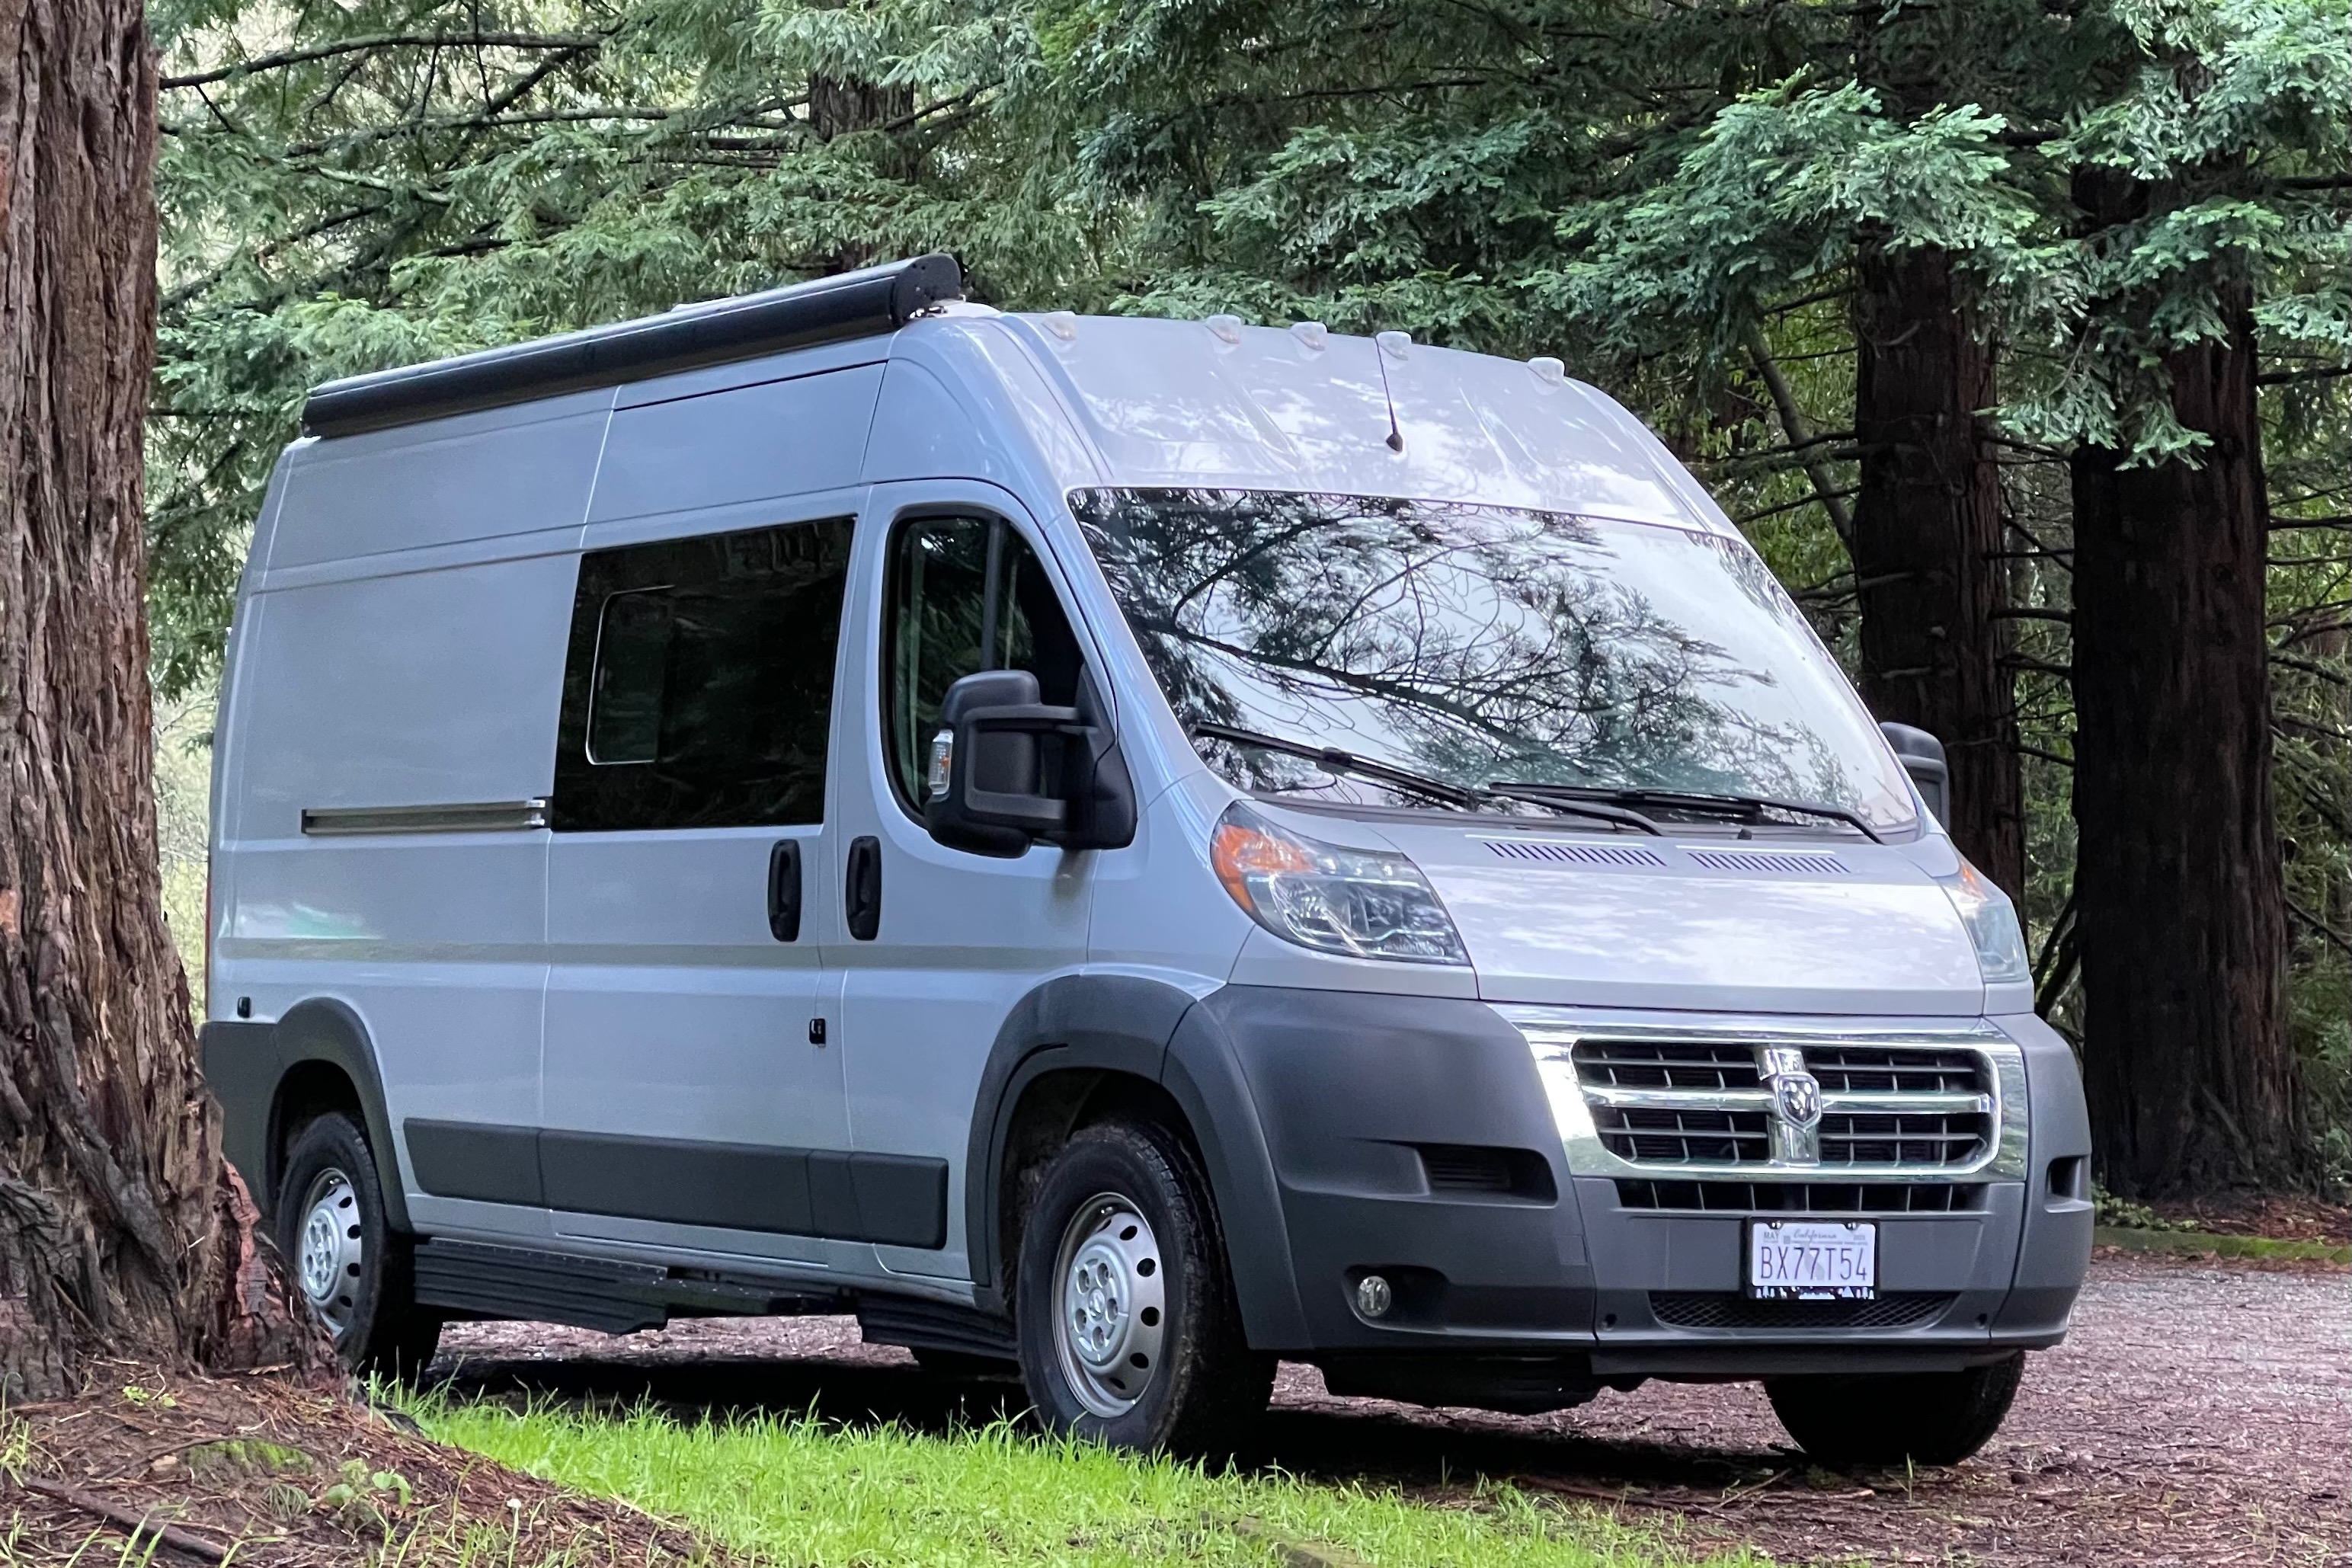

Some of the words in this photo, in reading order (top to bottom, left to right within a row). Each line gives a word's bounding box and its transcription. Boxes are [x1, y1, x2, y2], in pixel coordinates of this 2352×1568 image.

[1764, 1231, 1779, 1240] MAY
[1794, 1229, 1837, 1242] California
[1761, 1246, 1867, 1280] BX77T54
